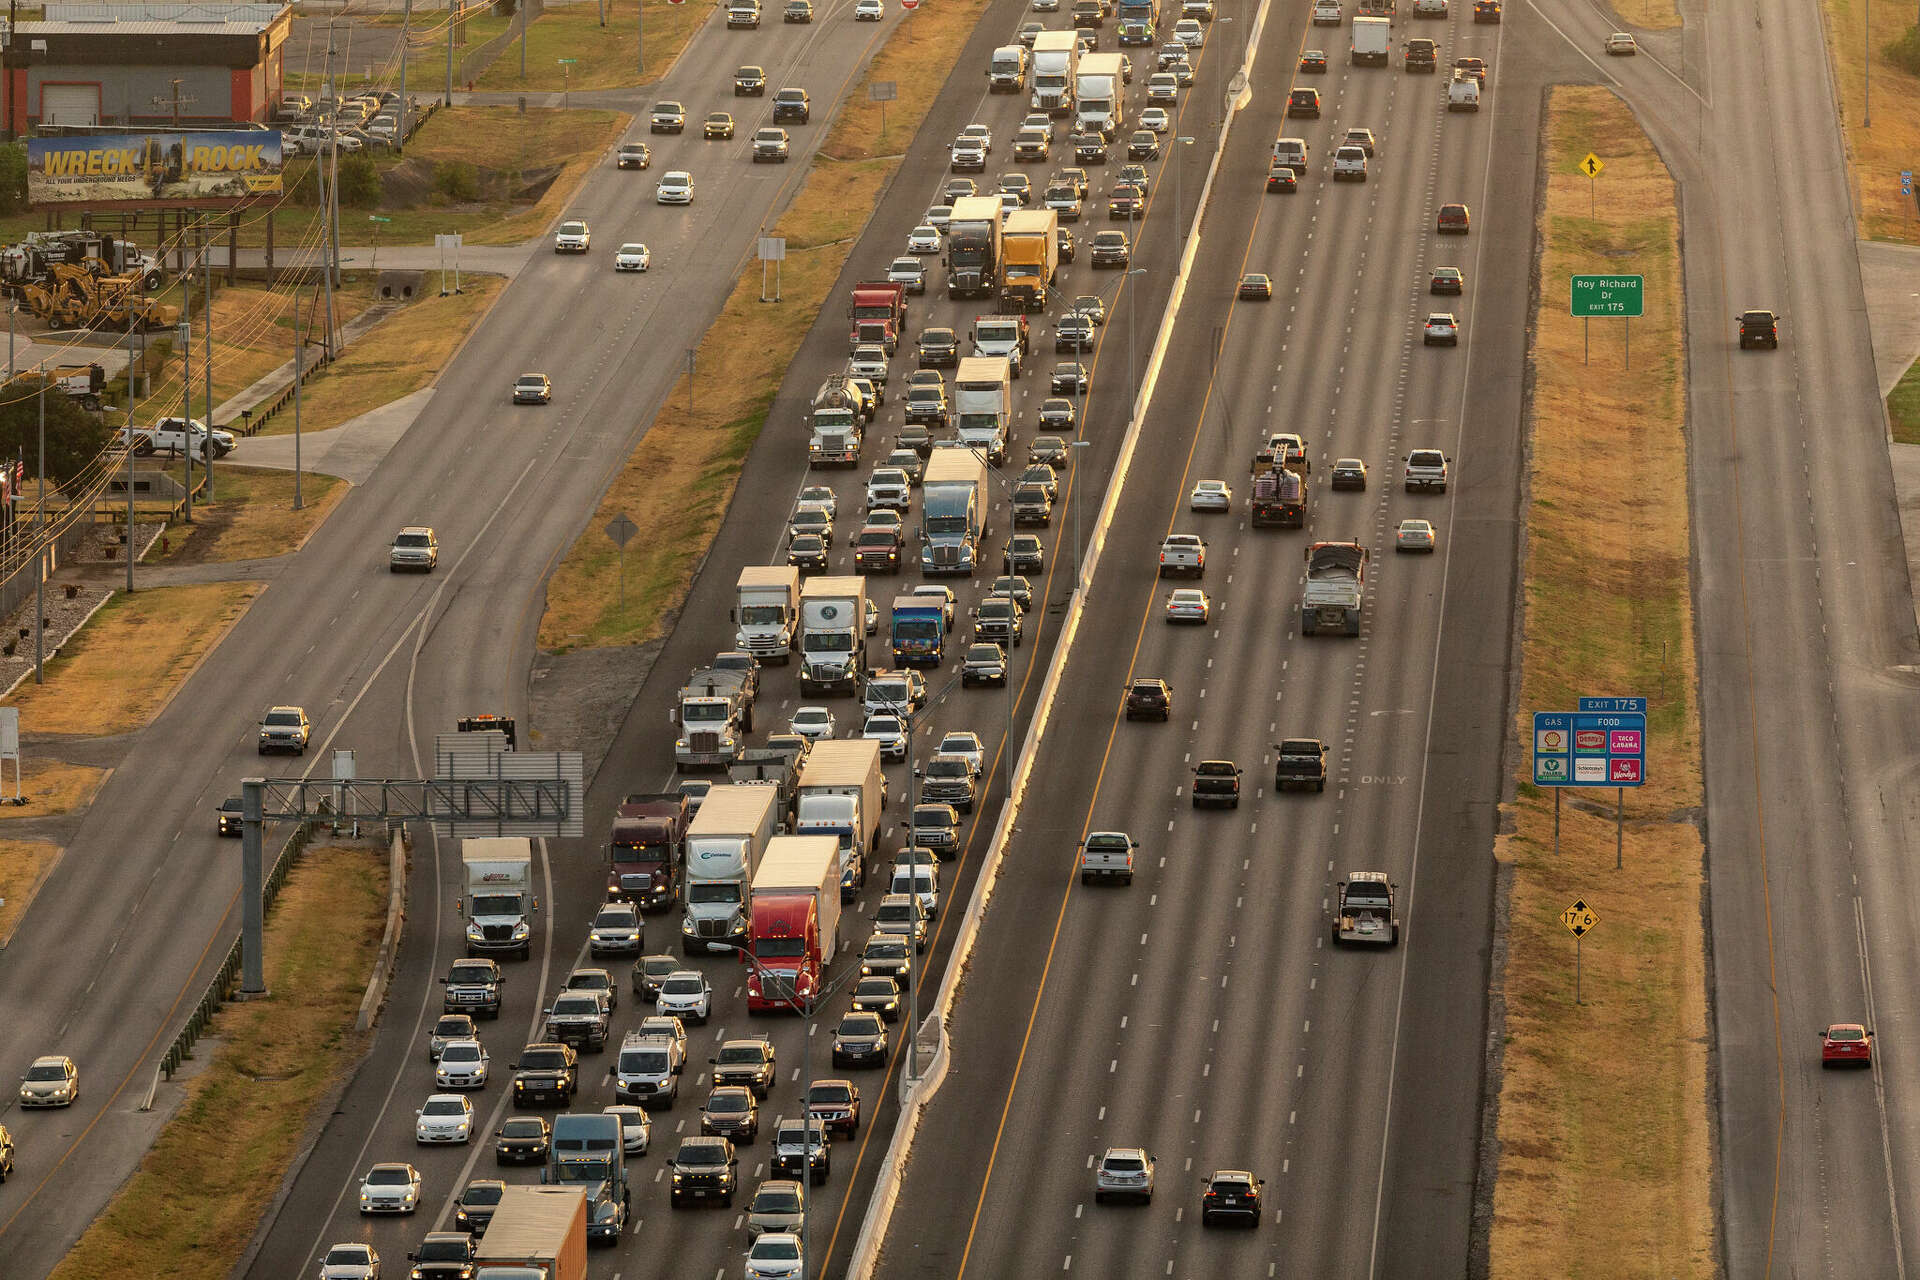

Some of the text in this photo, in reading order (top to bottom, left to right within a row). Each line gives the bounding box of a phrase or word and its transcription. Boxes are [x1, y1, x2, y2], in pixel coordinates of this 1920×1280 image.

[44, 144, 264, 177] WRECK ROCK
[1577, 280, 1636, 289] Roy Richard
[1601, 291, 1612, 299] Dr
[1607, 303, 1624, 311] 175
[1615, 700, 1637, 710] 175
[1598, 718, 1619, 726] FOOD
[1361, 776, 1407, 784] ONLY
